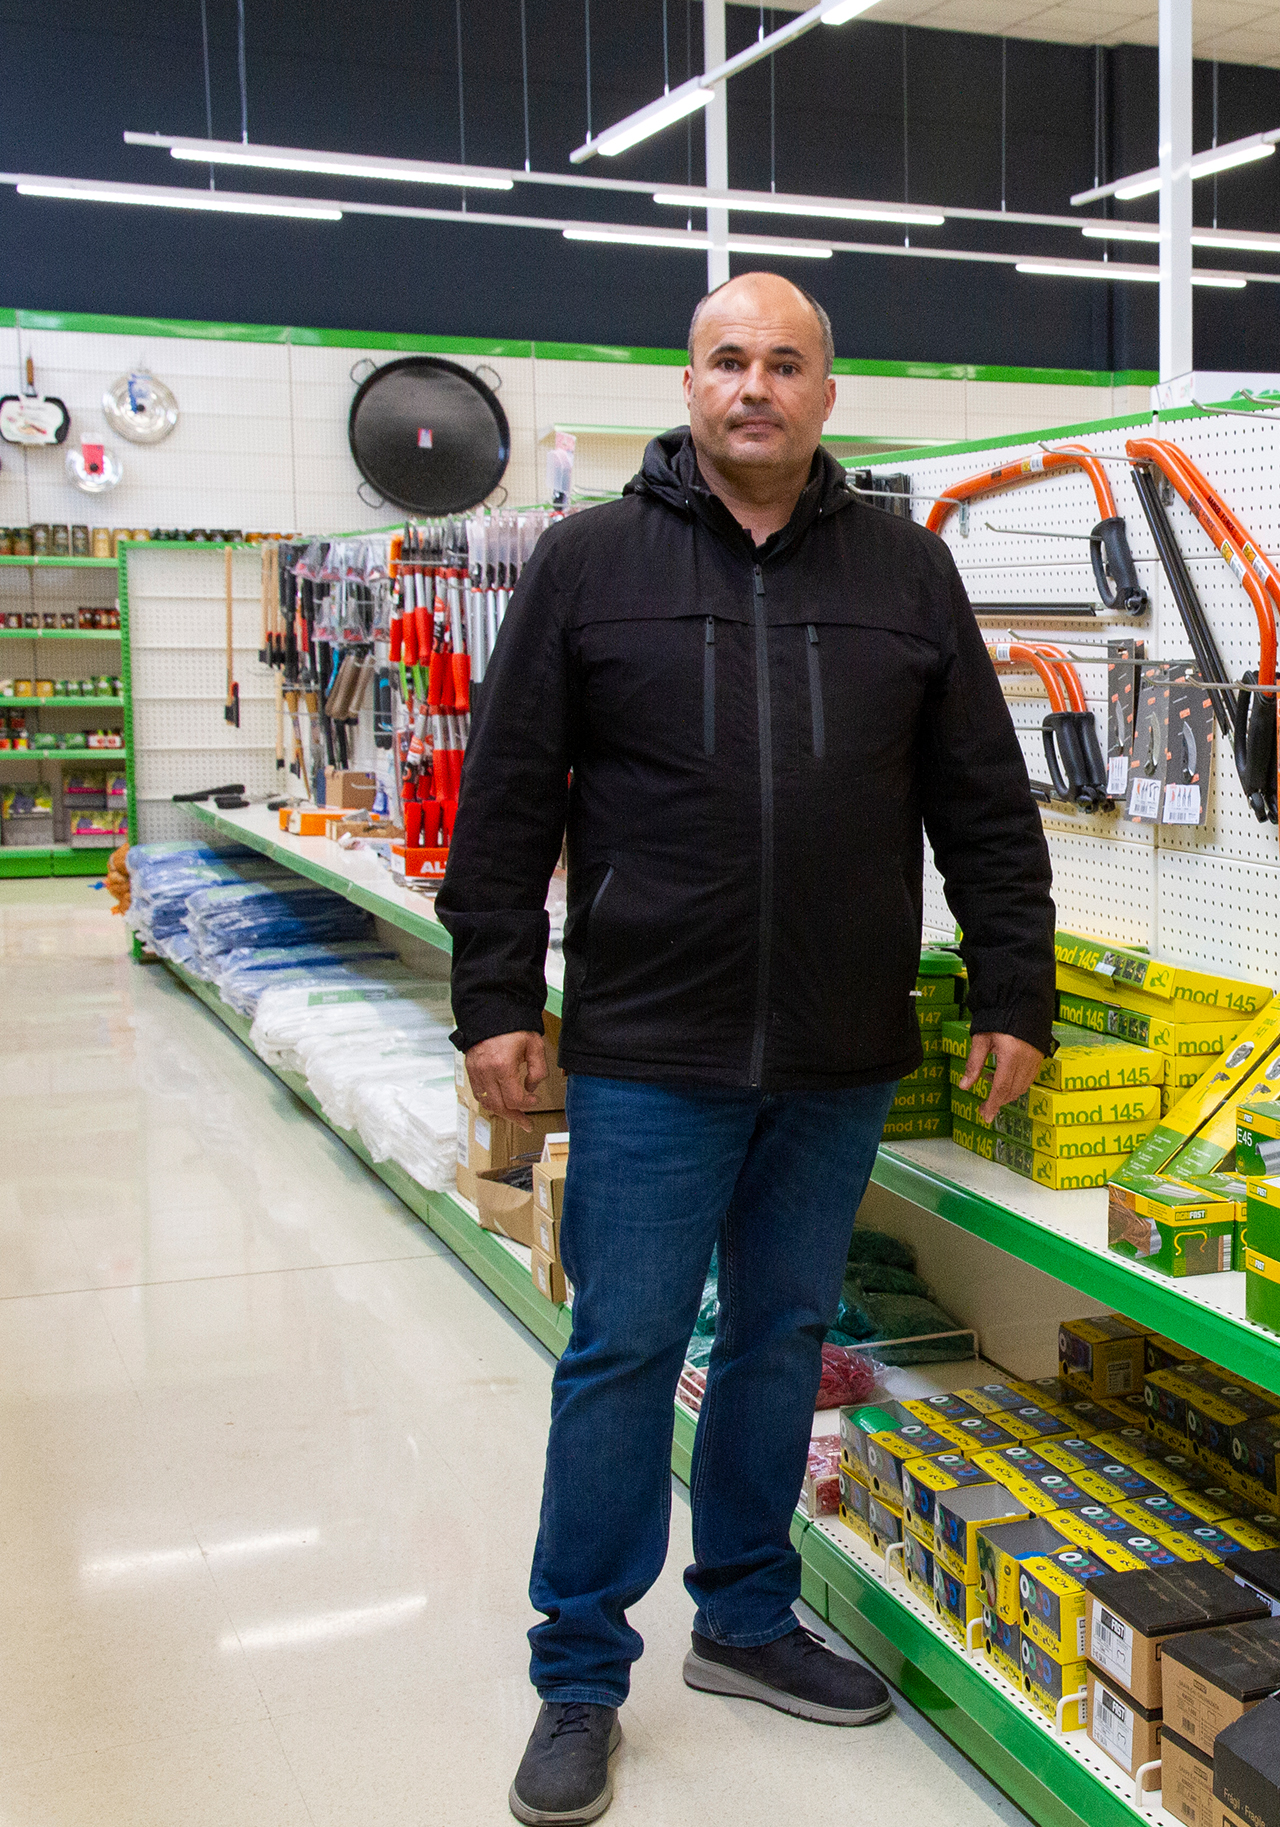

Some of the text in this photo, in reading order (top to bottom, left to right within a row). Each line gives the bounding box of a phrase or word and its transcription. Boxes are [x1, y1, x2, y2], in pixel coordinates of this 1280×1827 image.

[421, 861, 447, 873] AL
[1055, 946, 1100, 971] mod 145
[915, 986, 936, 997] 47
[1174, 986, 1256, 1011] mod 145
[919, 1012, 941, 1024] 147
[1060, 1004, 1104, 1032] mod 145
[942, 1037, 966, 1059] mod
[1178, 1035, 1223, 1054] mod
[922, 1067, 944, 1078] 147
[1064, 1067, 1150, 1089] mod 145
[920, 1092, 941, 1104] 147
[951, 1099, 972, 1120] mod
[1055, 1103, 1145, 1124] mod 145
[883, 1118, 940, 1133] mod 147
[953, 1128, 993, 1159] mod 145
[1060, 1137, 1105, 1157] mod
[1237, 1128, 1252, 1147] E45
[1061, 1169, 1106, 1188] mod
